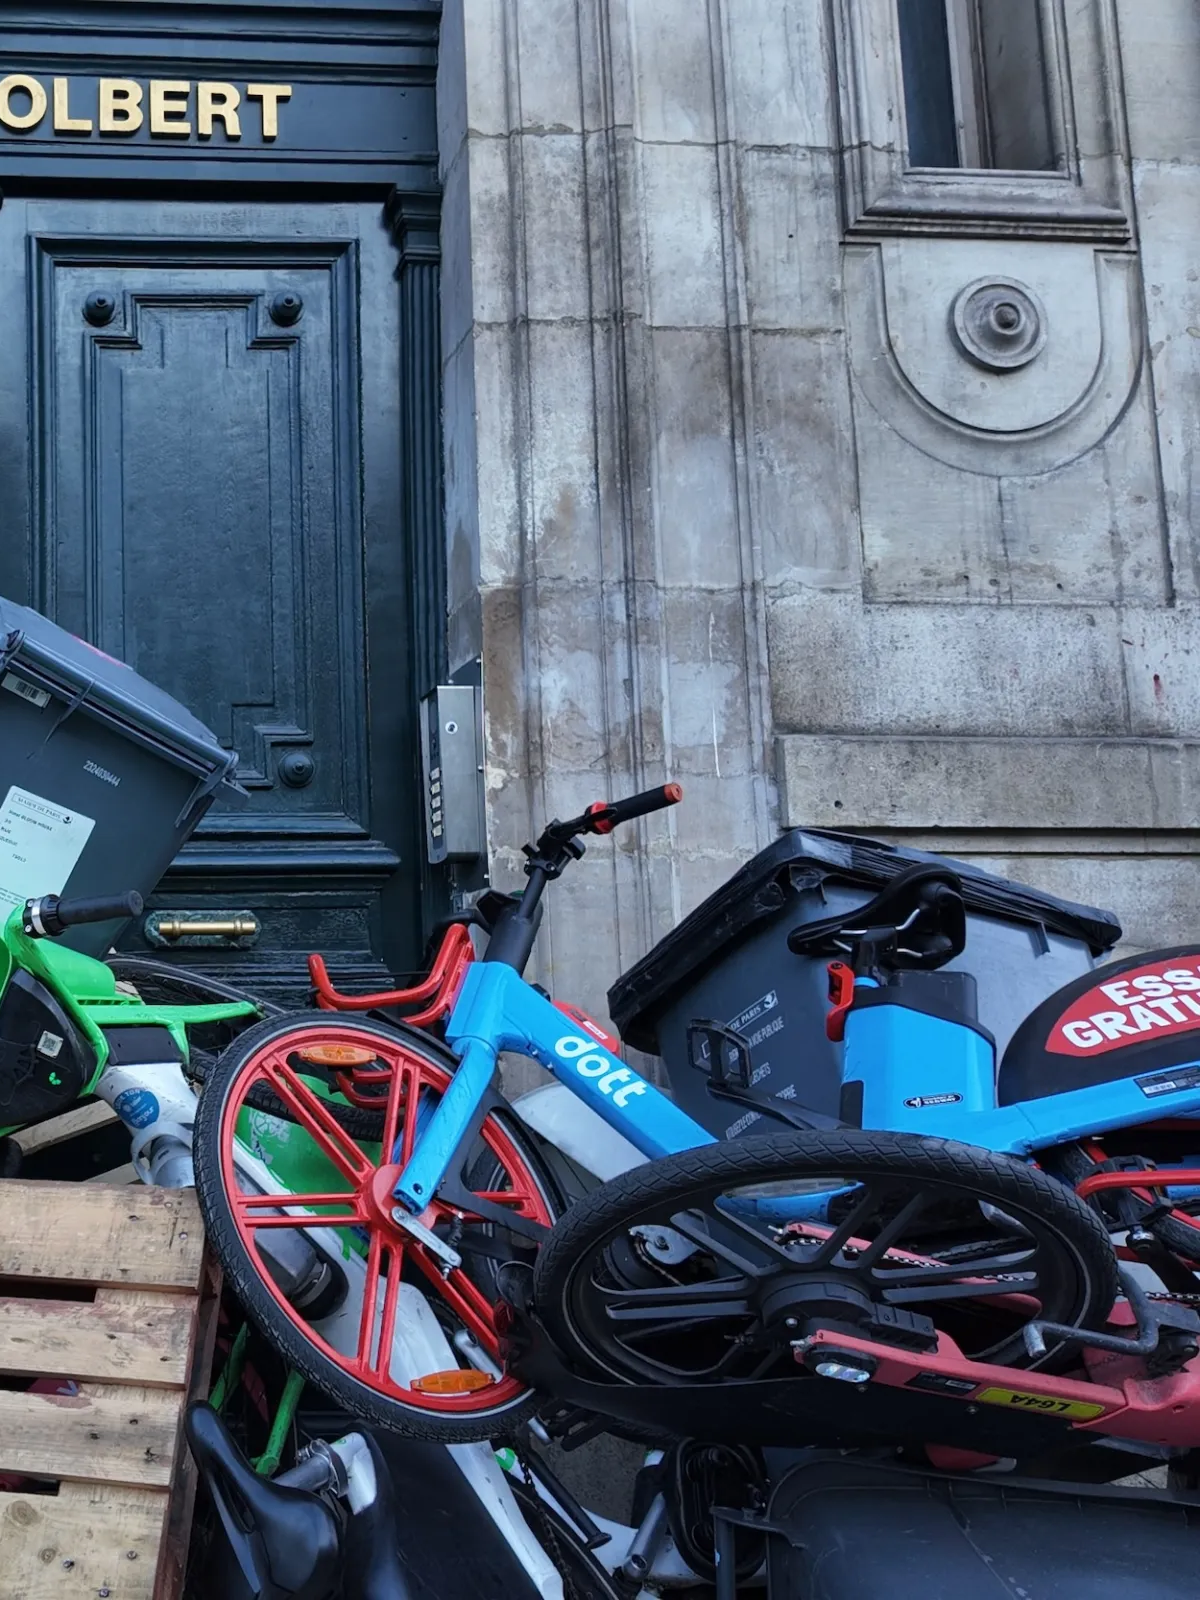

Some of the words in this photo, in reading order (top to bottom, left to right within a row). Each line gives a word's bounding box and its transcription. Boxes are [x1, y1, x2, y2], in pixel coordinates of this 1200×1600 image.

[1100, 965, 1200, 1006] ESS
[741, 1006, 761, 1023] PARIS
[555, 1036, 647, 1107] dott
